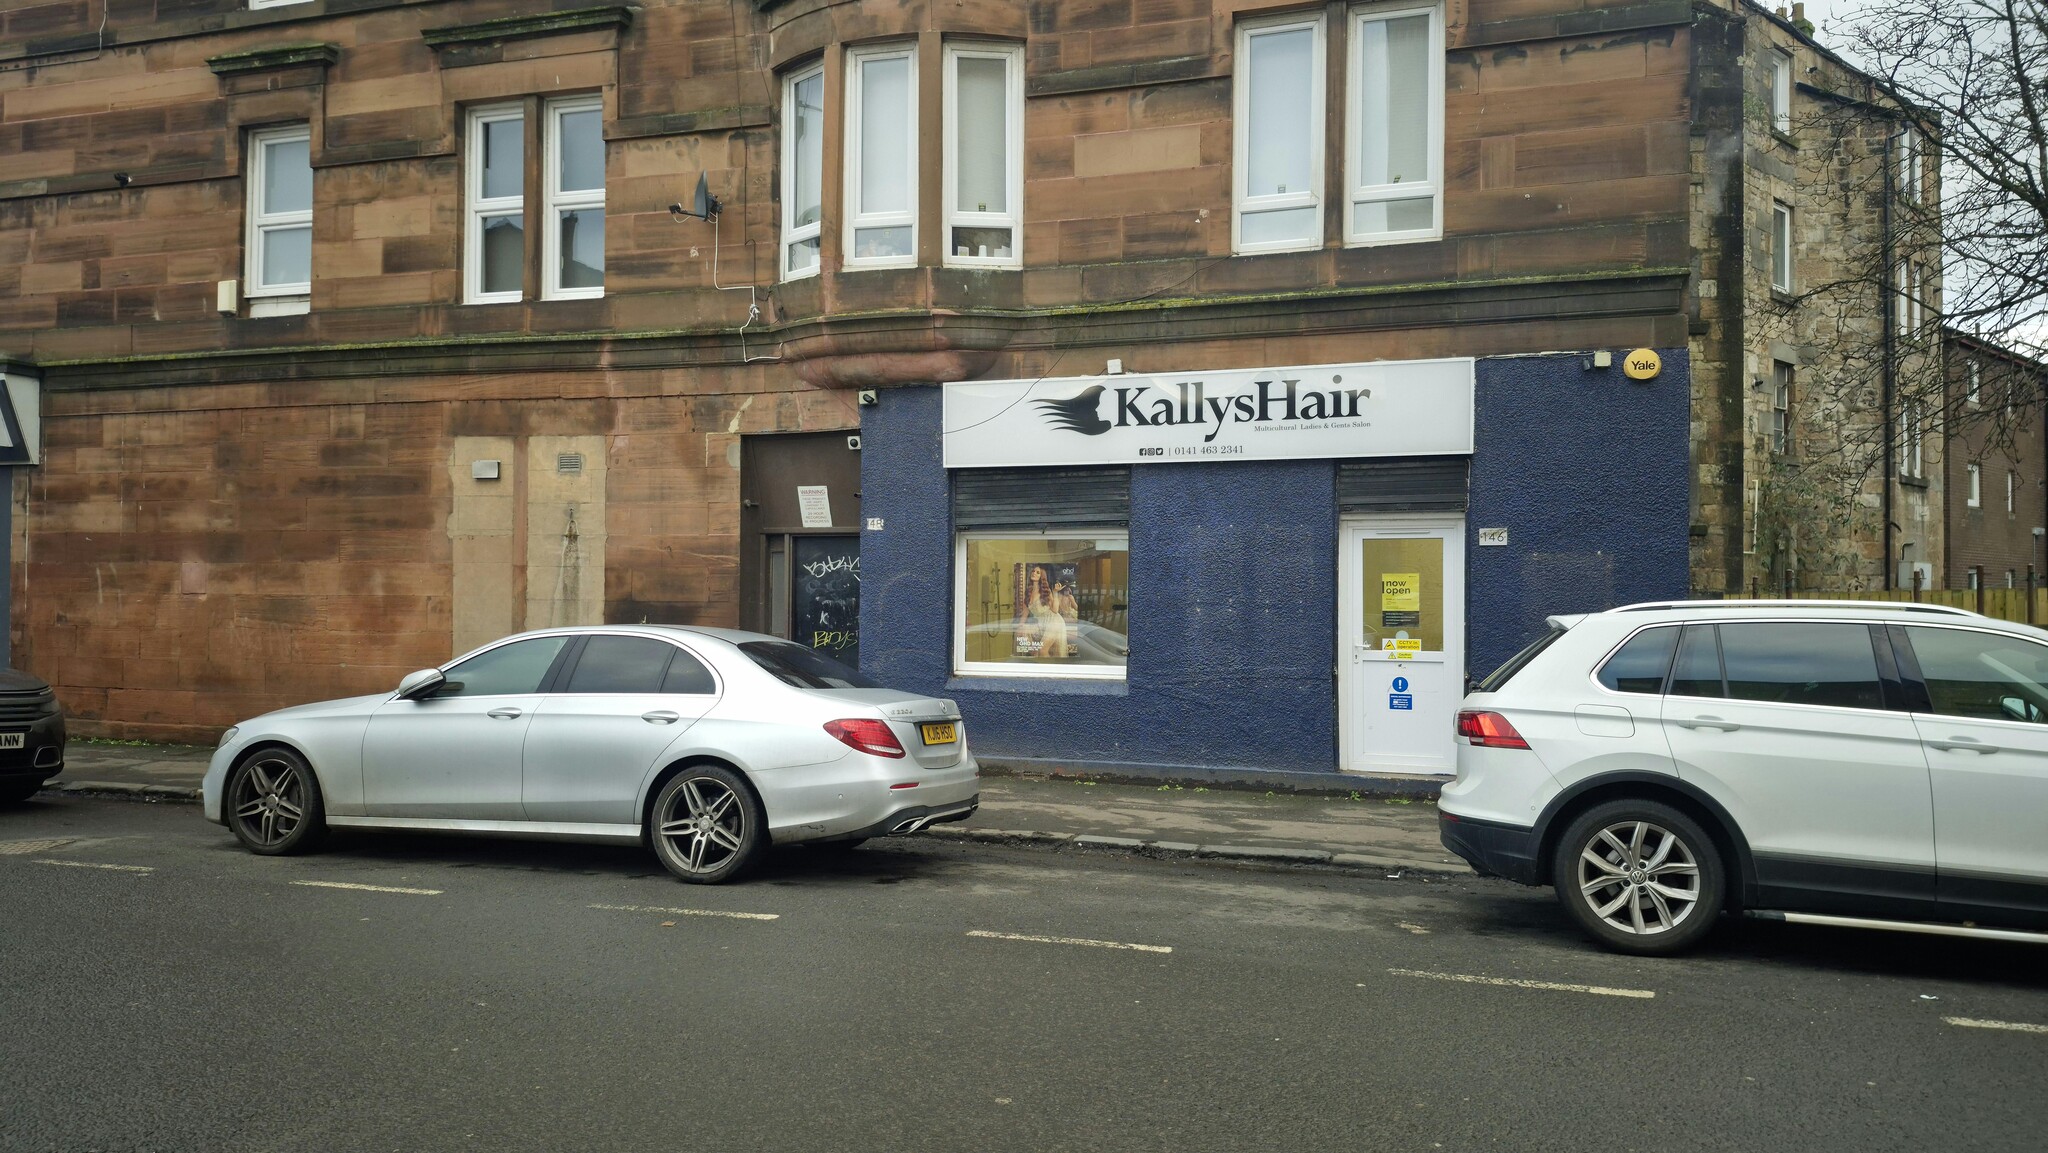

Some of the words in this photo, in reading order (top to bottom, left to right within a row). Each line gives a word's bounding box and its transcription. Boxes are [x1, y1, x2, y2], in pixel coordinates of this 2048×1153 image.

[1631, 360, 1656, 370] Yale
[1114, 374, 1372, 442] KallysHair
[1254, 424, 1297, 432] Multicultural
[1174, 446, 1197, 455] 0141
[1200, 446, 1218, 455] 463
[1220, 445, 1244, 454] 2341
[1483, 531, 1504, 542] 146
[1062, 567, 1075, 575] ghd
[1386, 588, 1411, 596] open
